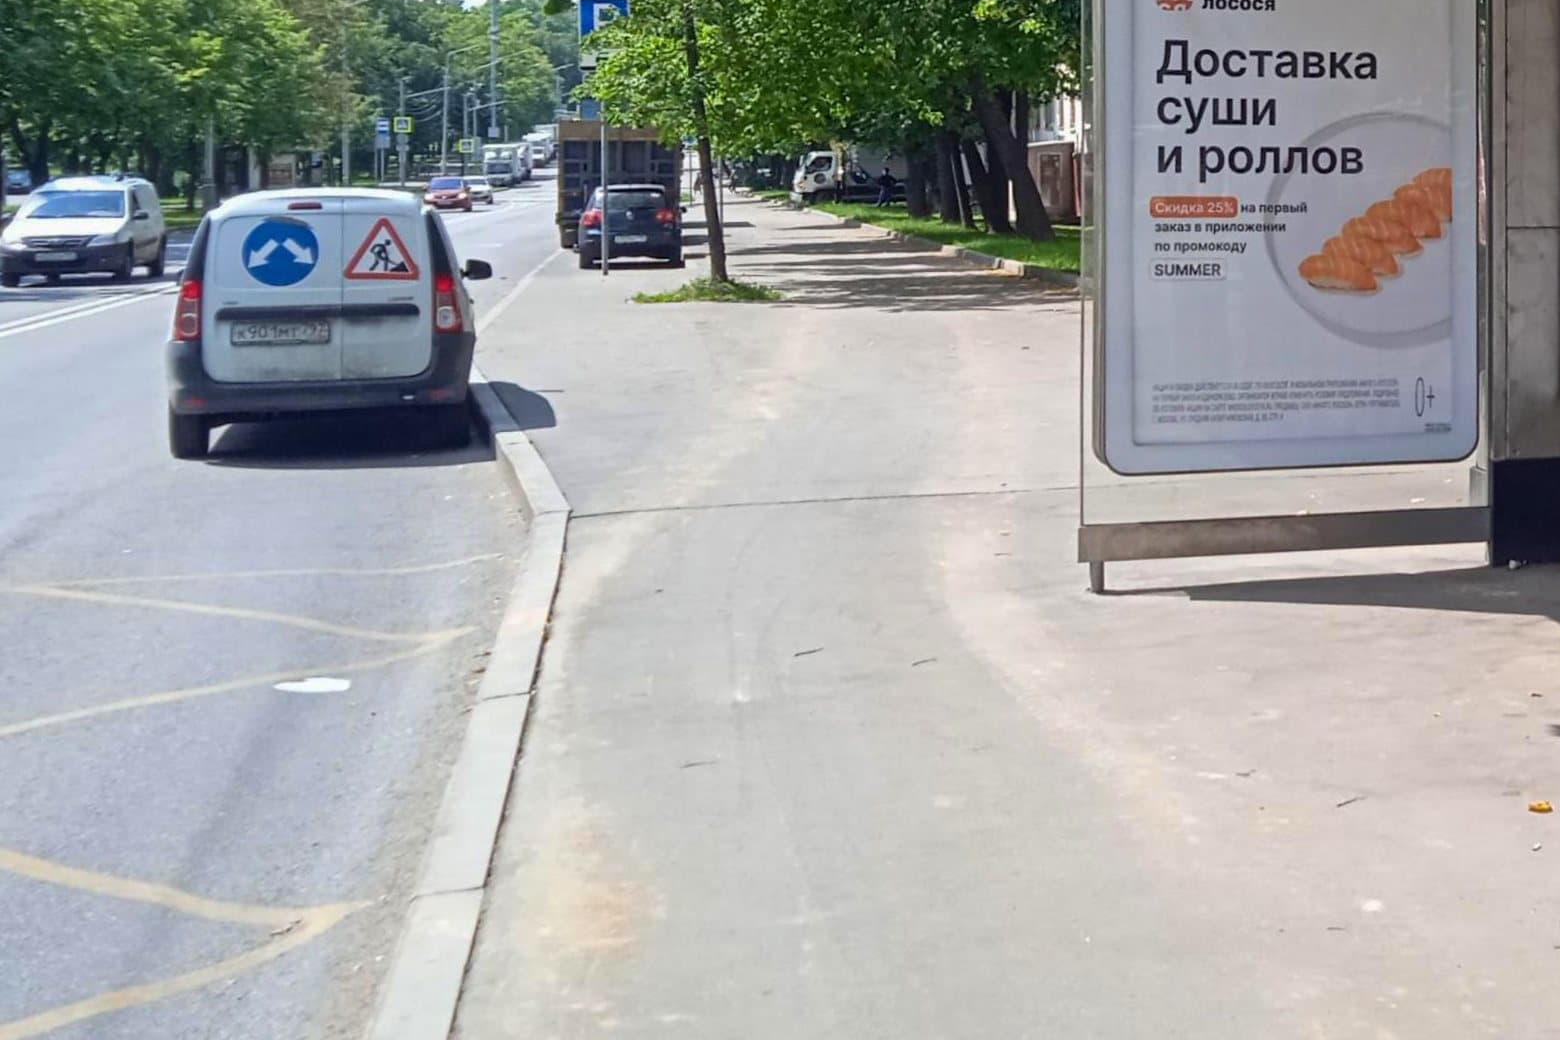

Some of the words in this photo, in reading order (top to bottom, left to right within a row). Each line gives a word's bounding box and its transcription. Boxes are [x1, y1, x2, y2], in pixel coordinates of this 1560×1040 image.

[1156, 40, 1377, 84] Доставка
[1157, 95, 1277, 134] суши
[1157, 146, 1182, 174] и
[1200, 145, 1363, 183] роллов
[1154, 201, 1203, 216] Скидка
[1207, 202, 1234, 214] 25%
[1240, 204, 1255, 213] на
[1258, 201, 1308, 216] первый
[1154, 223, 1191, 233] заказ
[1194, 223, 1202, 233] в
[1205, 222, 1286, 235] приложении
[1154, 241, 1171, 252] по
[1174, 241, 1247, 254] промокоду
[1154, 263, 1222, 277] SUMMER
[1415, 376, 1435, 417] 0+
